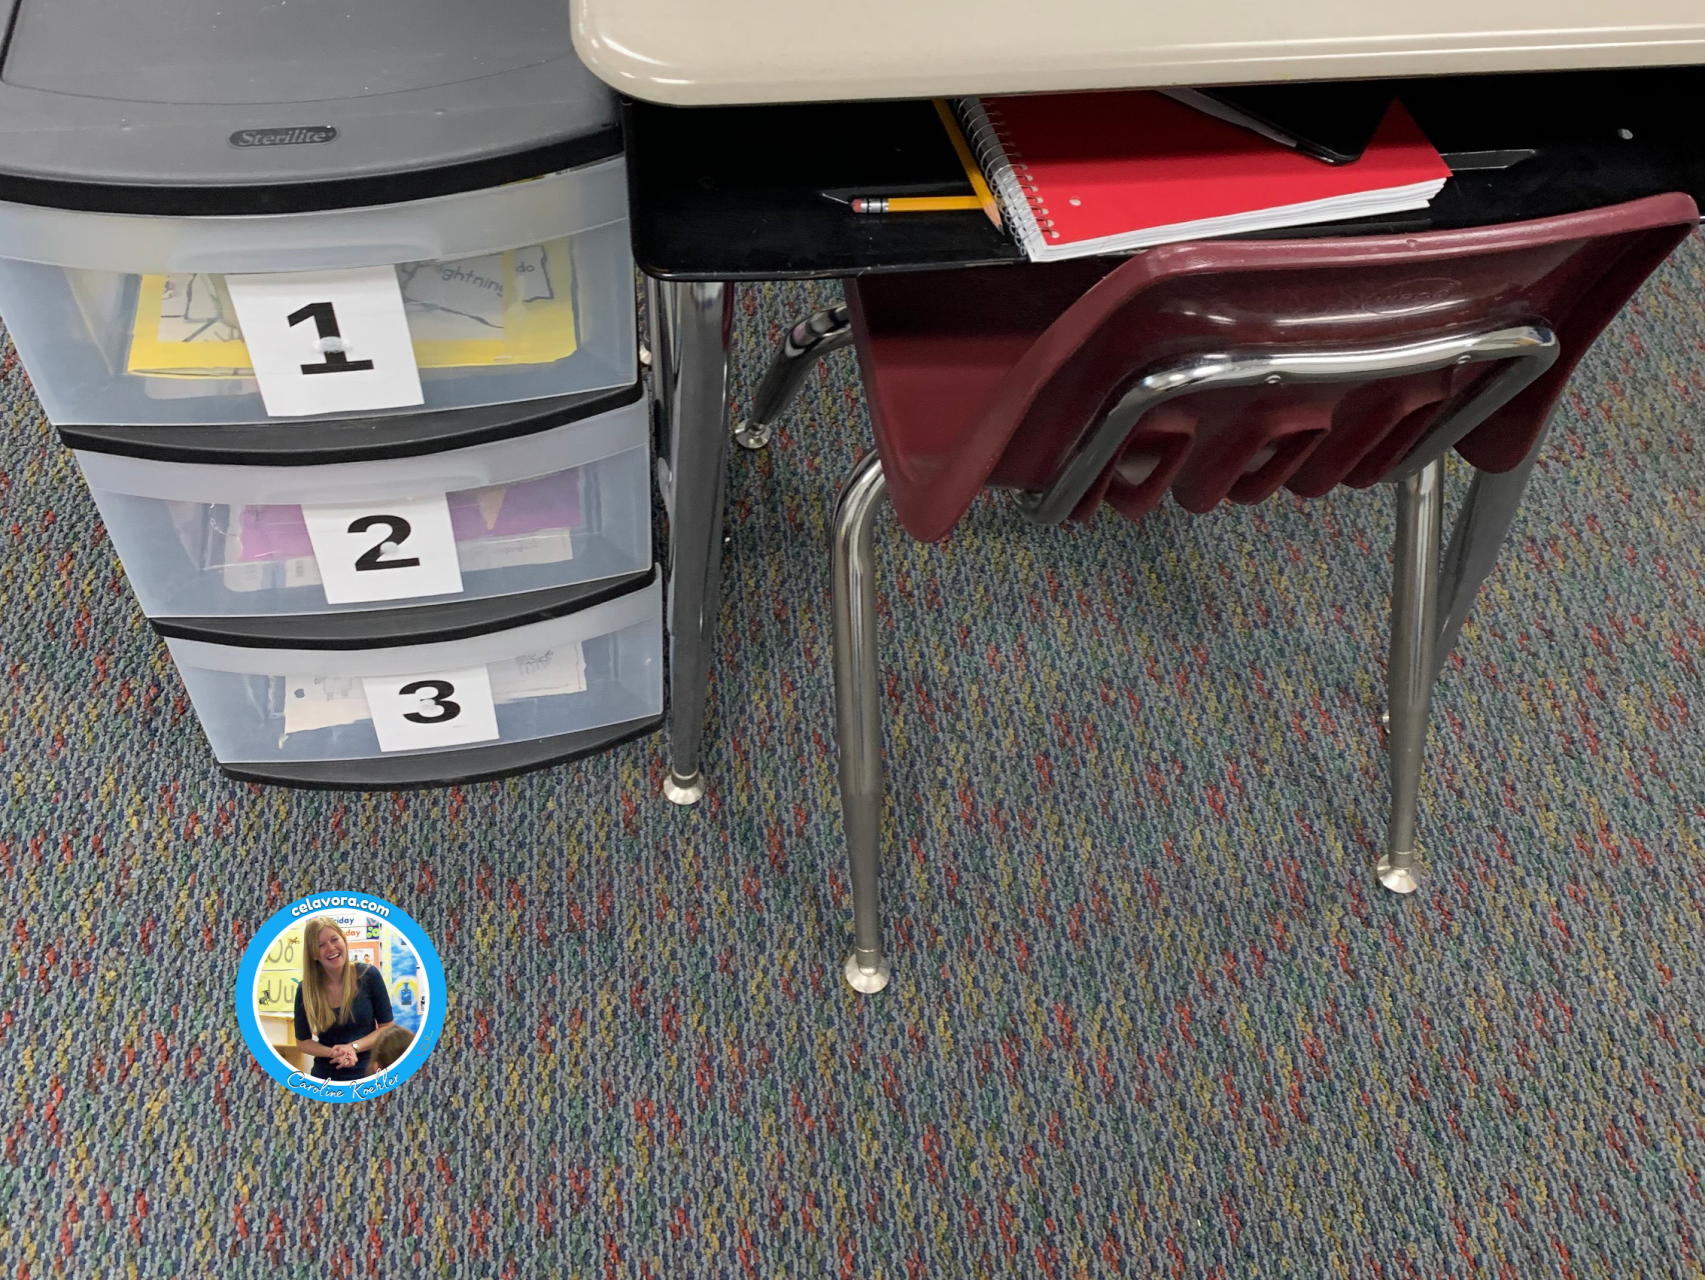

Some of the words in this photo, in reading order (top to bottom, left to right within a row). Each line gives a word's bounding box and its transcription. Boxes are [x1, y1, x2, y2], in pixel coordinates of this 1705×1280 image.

[239, 129, 327, 146] Sterilite
[287, 301, 374, 375] 1
[347, 514, 420, 572] 2
[398, 679, 462, 724] 3
